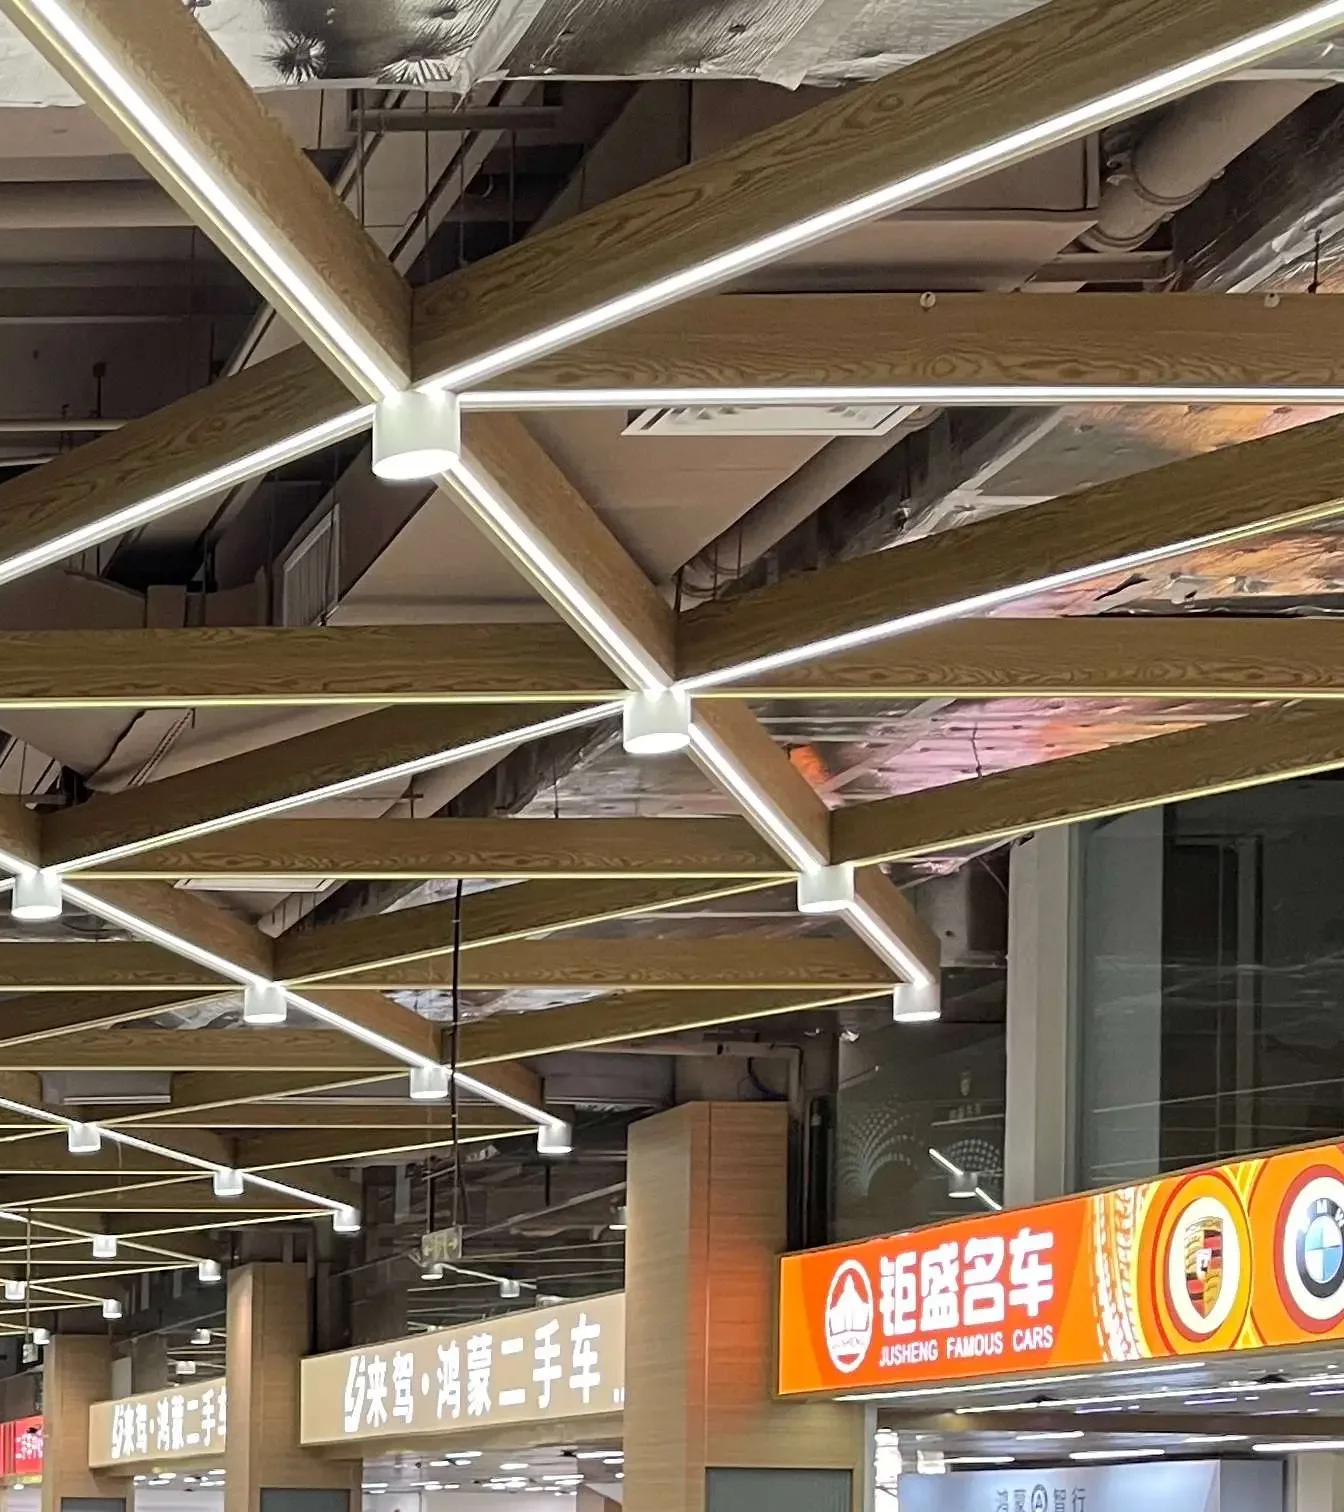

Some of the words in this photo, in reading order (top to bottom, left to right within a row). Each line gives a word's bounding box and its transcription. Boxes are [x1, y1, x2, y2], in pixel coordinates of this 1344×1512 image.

[879, 1227, 1054, 1337] 钜盛名车
[879, 1338, 938, 1367] JUSHENG
[945, 1331, 1004, 1359] FAMOUS
[1012, 1324, 1054, 1351] CARS
